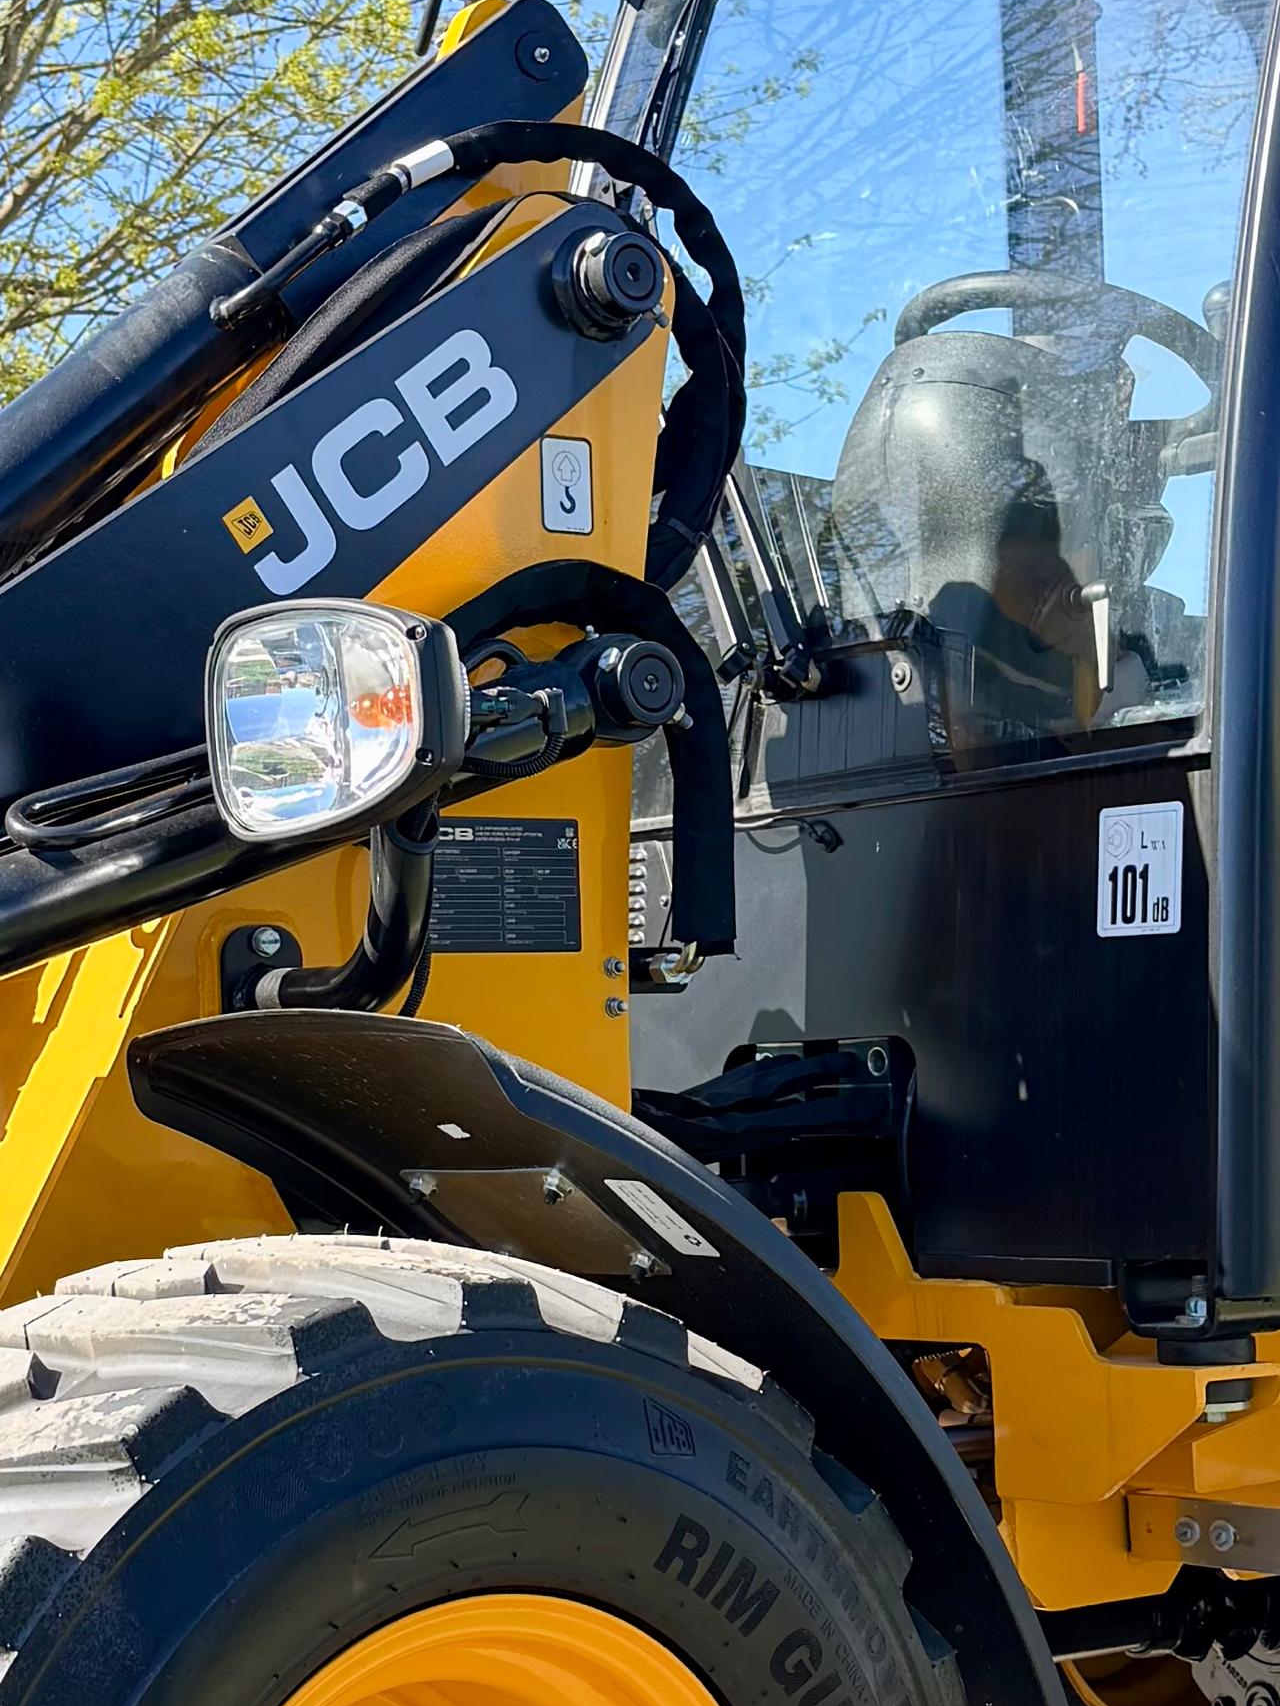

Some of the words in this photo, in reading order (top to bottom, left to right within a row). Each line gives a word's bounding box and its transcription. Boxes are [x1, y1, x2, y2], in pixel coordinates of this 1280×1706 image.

[253, 330, 518, 595] JCB
[235, 512, 261, 537] JCB
[438, 827, 474, 841] CB
[1108, 863, 1150, 925] 101
[1152, 896, 1170, 923] dB
[653, 1513, 782, 1639] RIM
[783, 1567, 824, 1622] MADE
[821, 1618, 837, 1642] IN
